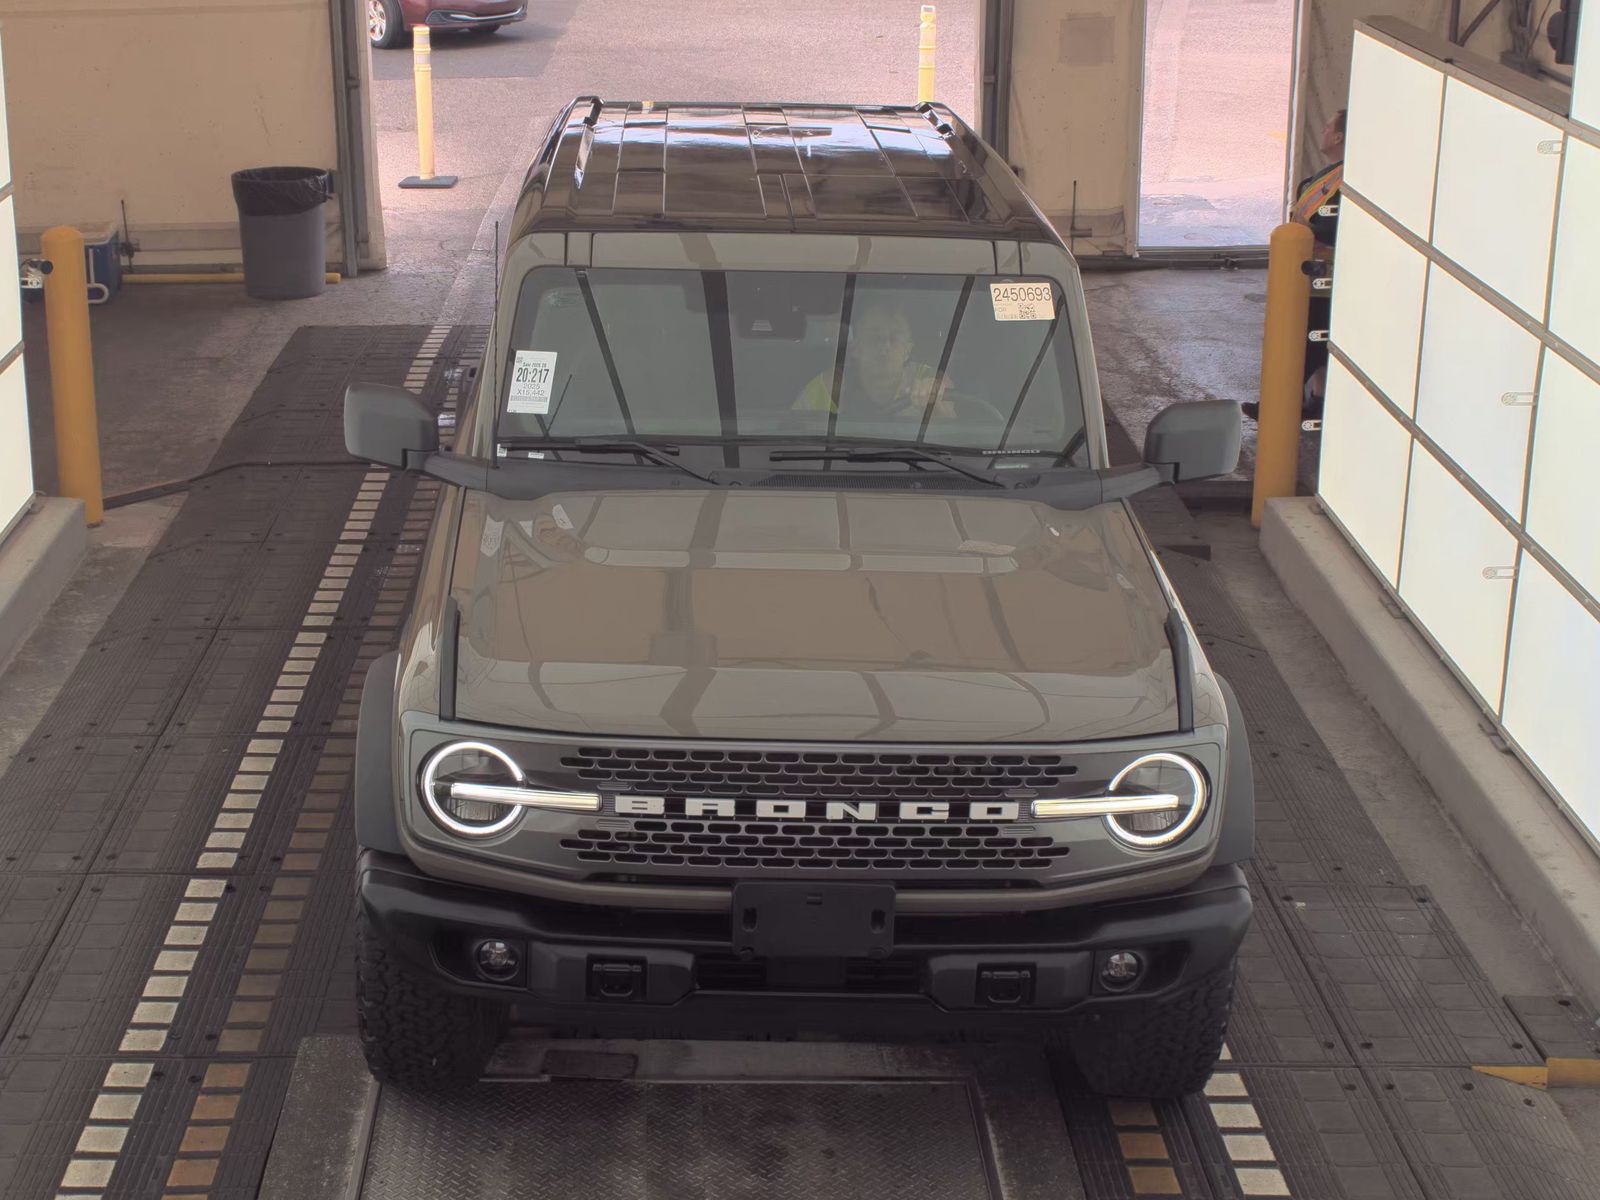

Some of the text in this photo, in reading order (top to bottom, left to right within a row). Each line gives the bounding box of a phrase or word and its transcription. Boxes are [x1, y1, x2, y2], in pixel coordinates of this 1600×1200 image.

[993, 287, 1051, 301] 2450693
[516, 367, 549, 383] 20:217
[615, 795, 1020, 821] BRONCO
